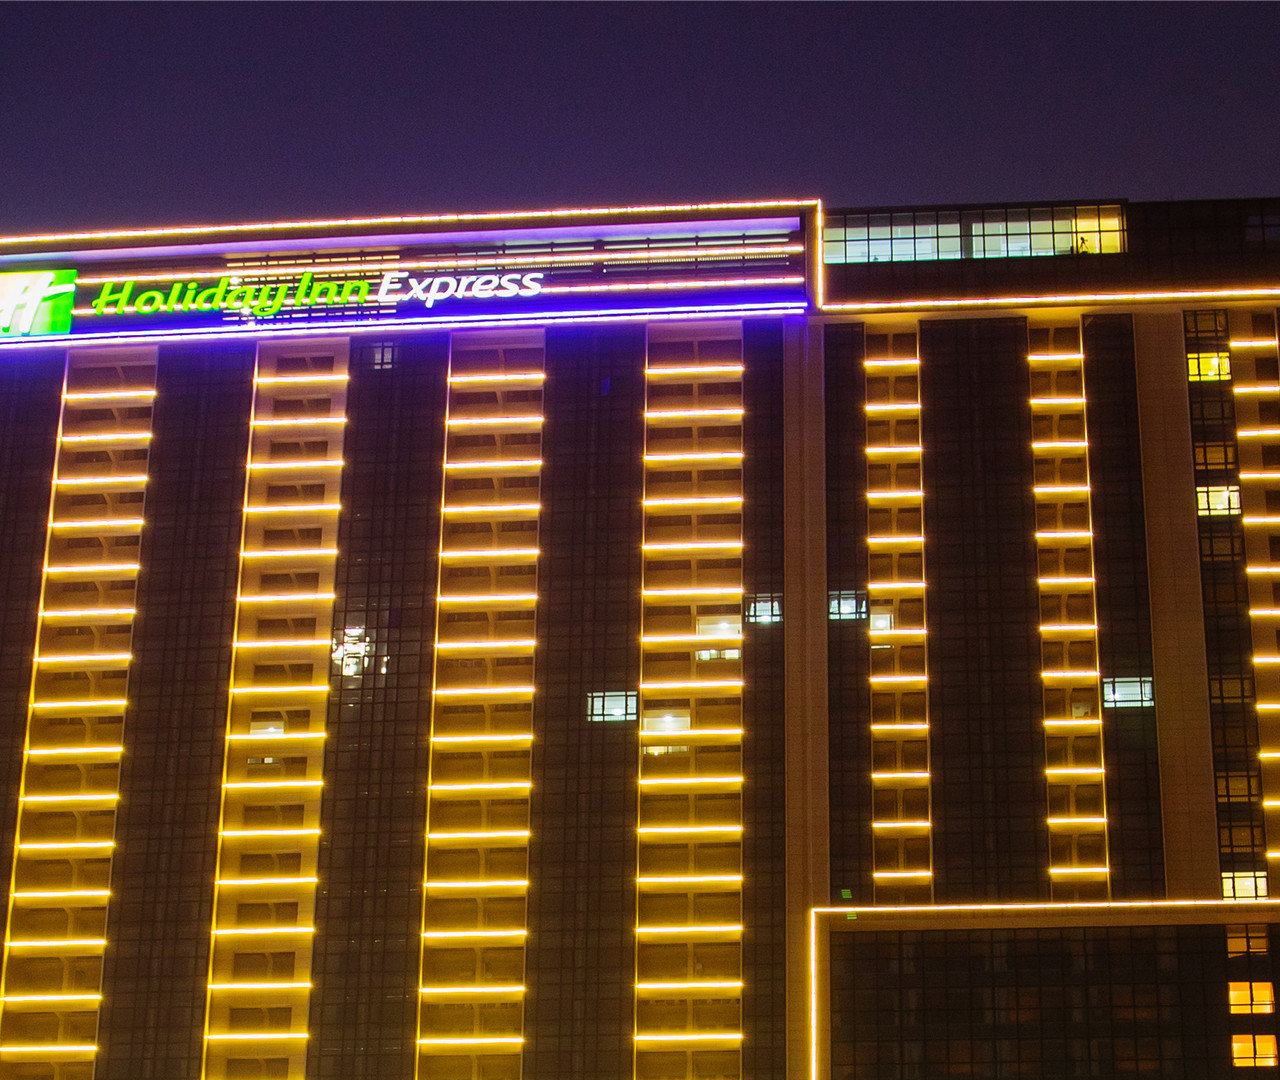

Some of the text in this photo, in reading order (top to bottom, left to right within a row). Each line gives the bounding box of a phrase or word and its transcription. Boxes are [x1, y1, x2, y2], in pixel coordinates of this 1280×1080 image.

[92, 275, 285, 317] Holiday
[292, 272, 372, 305] Inn
[376, 270, 546, 308] Express
